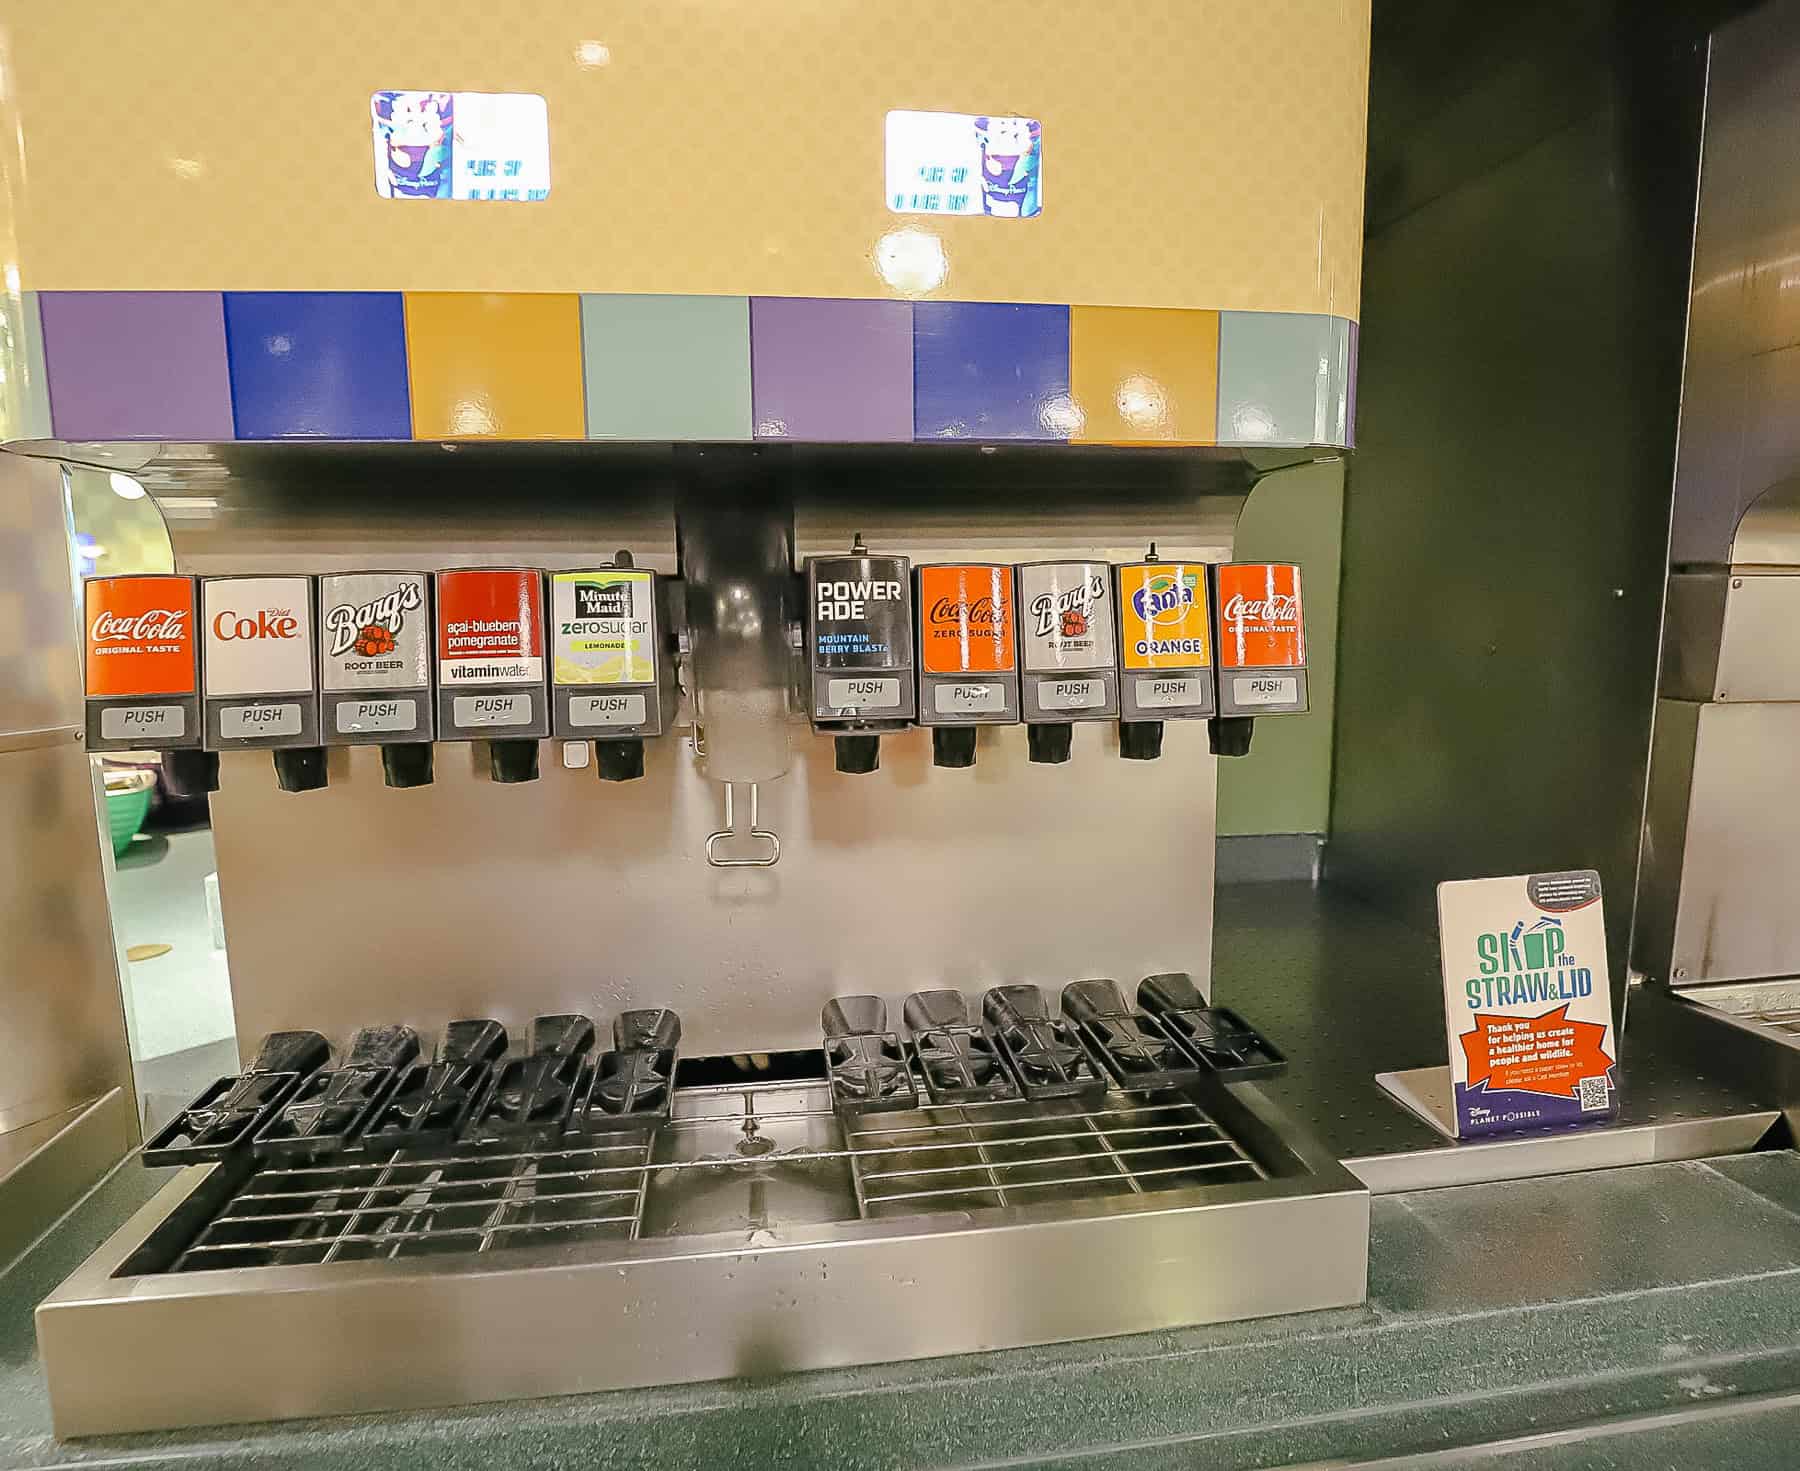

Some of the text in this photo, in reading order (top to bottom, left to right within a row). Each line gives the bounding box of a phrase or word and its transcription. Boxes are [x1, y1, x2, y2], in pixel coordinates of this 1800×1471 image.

[579, 589, 629, 601] Minute
[817, 581, 901, 601] POWER
[587, 602, 620, 613] Maid
[818, 601, 865, 620] ADE
[91, 609, 189, 641] Coca-Cola
[213, 611, 297, 641] Coke
[327, 582, 422, 657] Barq's
[447, 620, 522, 635] açai-blueberry
[934, 629, 1006, 638] ZERO SUGR
[448, 634, 518, 649] pomegranate
[818, 633, 869, 643] MOUNTAIN
[95, 645, 181, 656] ORIGINAL TASTE
[818, 645, 850, 654] BERRY
[1136, 639, 1200, 655] ORANGE
[344, 660, 404, 671] ROOT BEER
[848, 682, 883, 694] PUSH
[1056, 683, 1090, 696] PUSH
[1154, 682, 1186, 694] PUSH
[1251, 680, 1283, 692] PUSH
[358, 704, 398, 717] PUSH
[474, 699, 513, 712] PUSH
[590, 698, 628, 711] PUSH
[124, 711, 165, 724] PUSH
[241, 709, 283, 722] PUSH
[1558, 953, 1575, 966] the
[1488, 1022, 1530, 1033] Thank you
[1488, 1028, 1574, 1044] for helping us create
[1496, 1042, 1535, 1054] healthier
[1536, 1040, 1560, 1049] home
[1489, 1055, 1520, 1068] people
[1521, 1052, 1538, 1062] and
